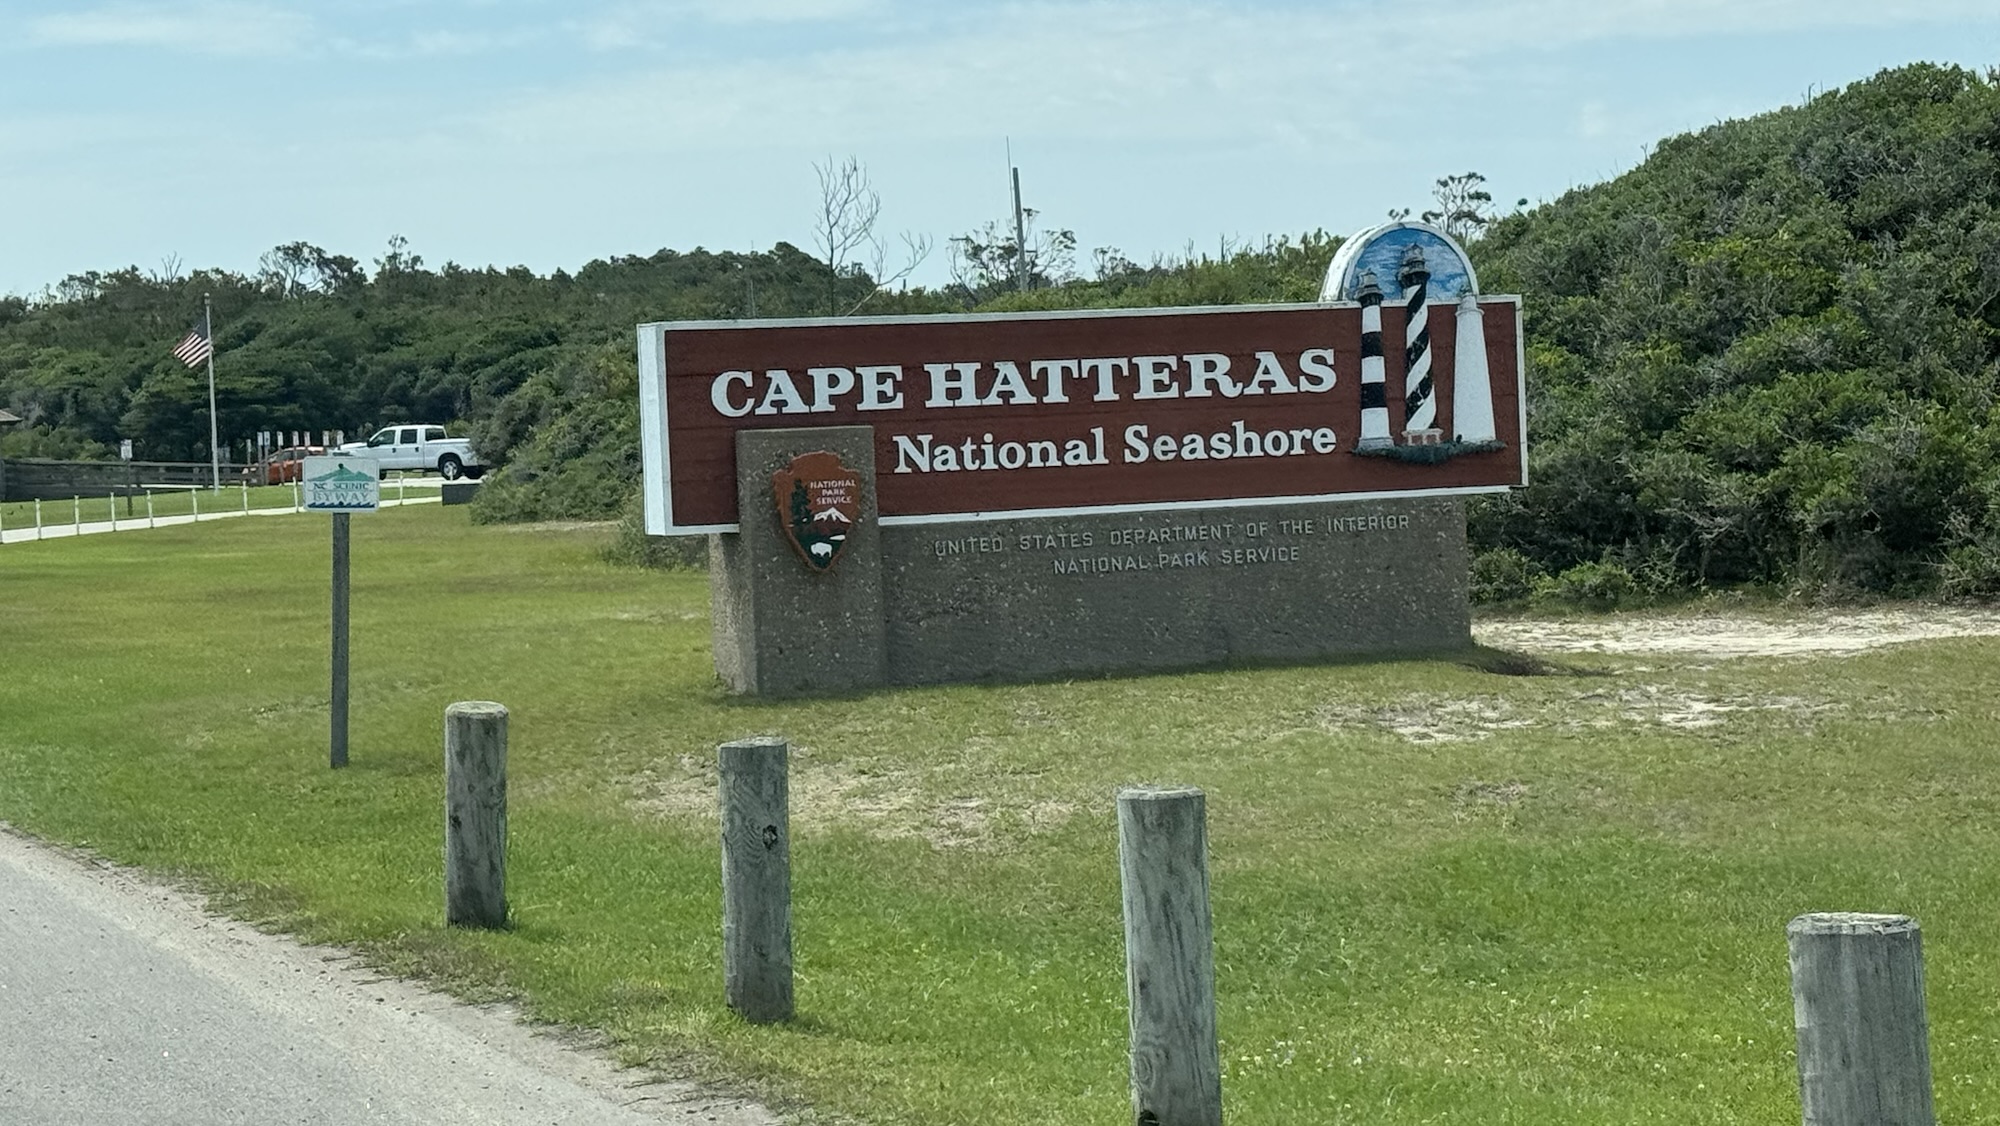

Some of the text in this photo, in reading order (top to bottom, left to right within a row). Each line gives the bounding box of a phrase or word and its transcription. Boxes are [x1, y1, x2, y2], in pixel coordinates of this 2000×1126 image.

[711, 348, 1338, 418] CAPE HATTERAS
[892, 420, 1337, 474] National Seashore
[313, 482, 370, 490] NC SCENIC
[810, 479, 857, 489] NATIONAL
[313, 492, 369, 502] BYWAY
[821, 488, 846, 496] PARK
[816, 496, 852, 505] SERVICE
[935, 514, 1410, 557] UNITED STATES DEPARTMENT OF THE INTERIOR
[1054, 547, 1300, 575] NATIONAL PARK SERVICE
